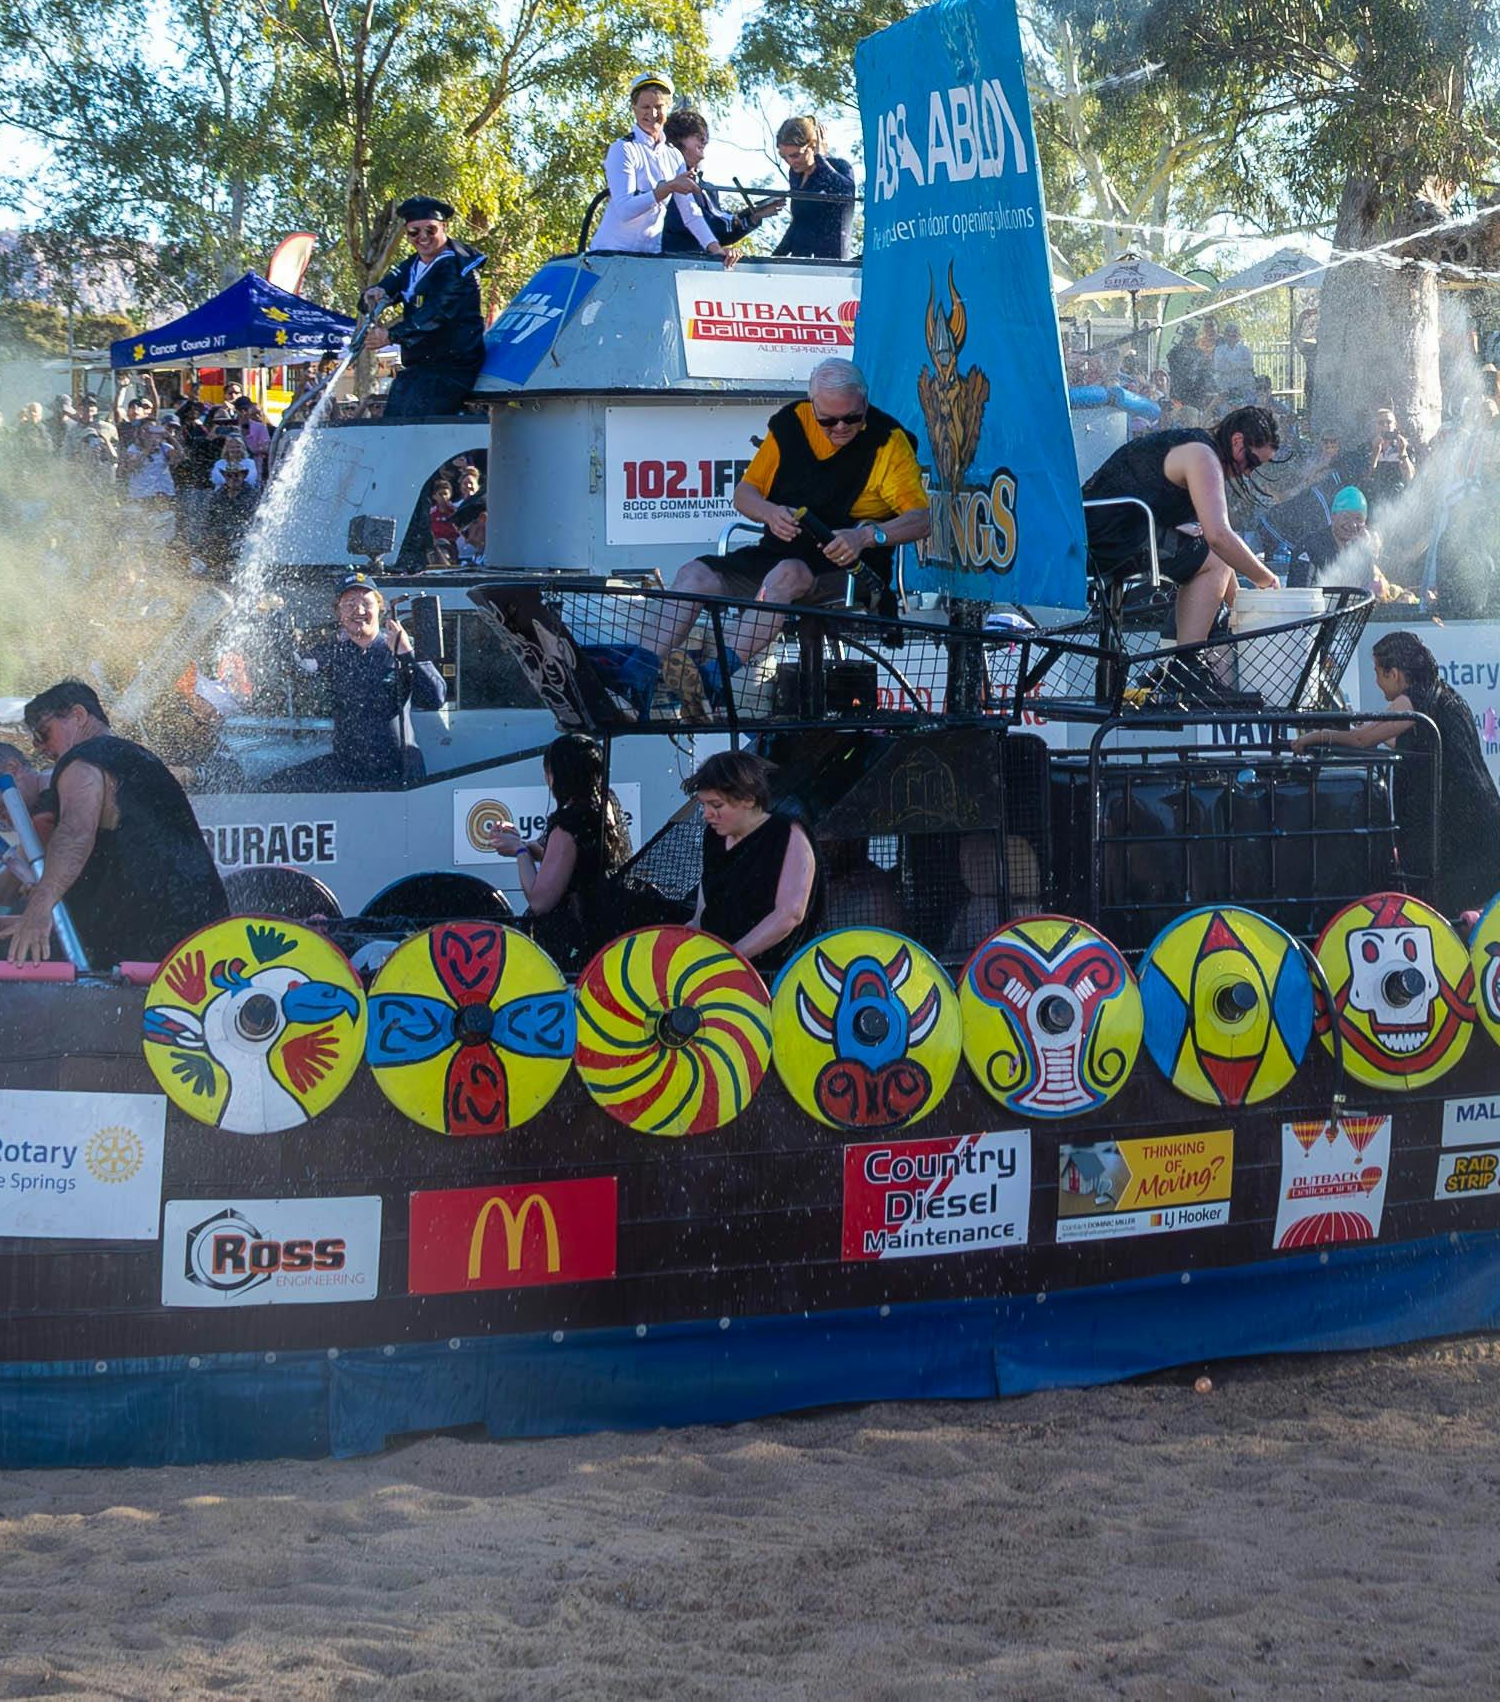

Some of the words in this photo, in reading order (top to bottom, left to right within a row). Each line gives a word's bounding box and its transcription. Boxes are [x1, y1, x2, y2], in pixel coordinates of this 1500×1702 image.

[927, 78, 1028, 186] ABLOY
[694, 300, 834, 323] OUTBACK
[697, 321, 839, 344] ballooning
[150, 343, 177, 356] Cancer
[182, 337, 211, 351] Council
[213, 335, 227, 348] NT
[789, 345, 839, 355] SPRINGS
[623, 501, 656, 511] 8CCC
[660, 500, 734, 511] COMMUNITY
[623, 511, 648, 520] ALICE
[650, 511, 690, 520] SPRINGS
[692, 510, 701, 519] &
[1438, 661, 1500, 690] otary
[1142, 1140, 1206, 1160] THINKING
[864, 1143, 1018, 1185] Country
[1165, 1160, 1183, 1174] OF
[1454, 1154, 1498, 1174] RAID
[10, 1172, 77, 1194] Springs
[1134, 1156, 1226, 1204] Moving?
[1291, 1182, 1359, 1197] ballooning
[1292, 1172, 1360, 1187] OUTBACK
[1445, 1172, 1495, 1193] STRIP
[884, 1184, 998, 1226] Diesel
[1164, 1212, 1175, 1229] LJ
[1178, 1207, 1222, 1225] Hooker
[863, 1220, 1015, 1253] Maintenance
[275, 1271, 366, 1288] ENGINEERING
